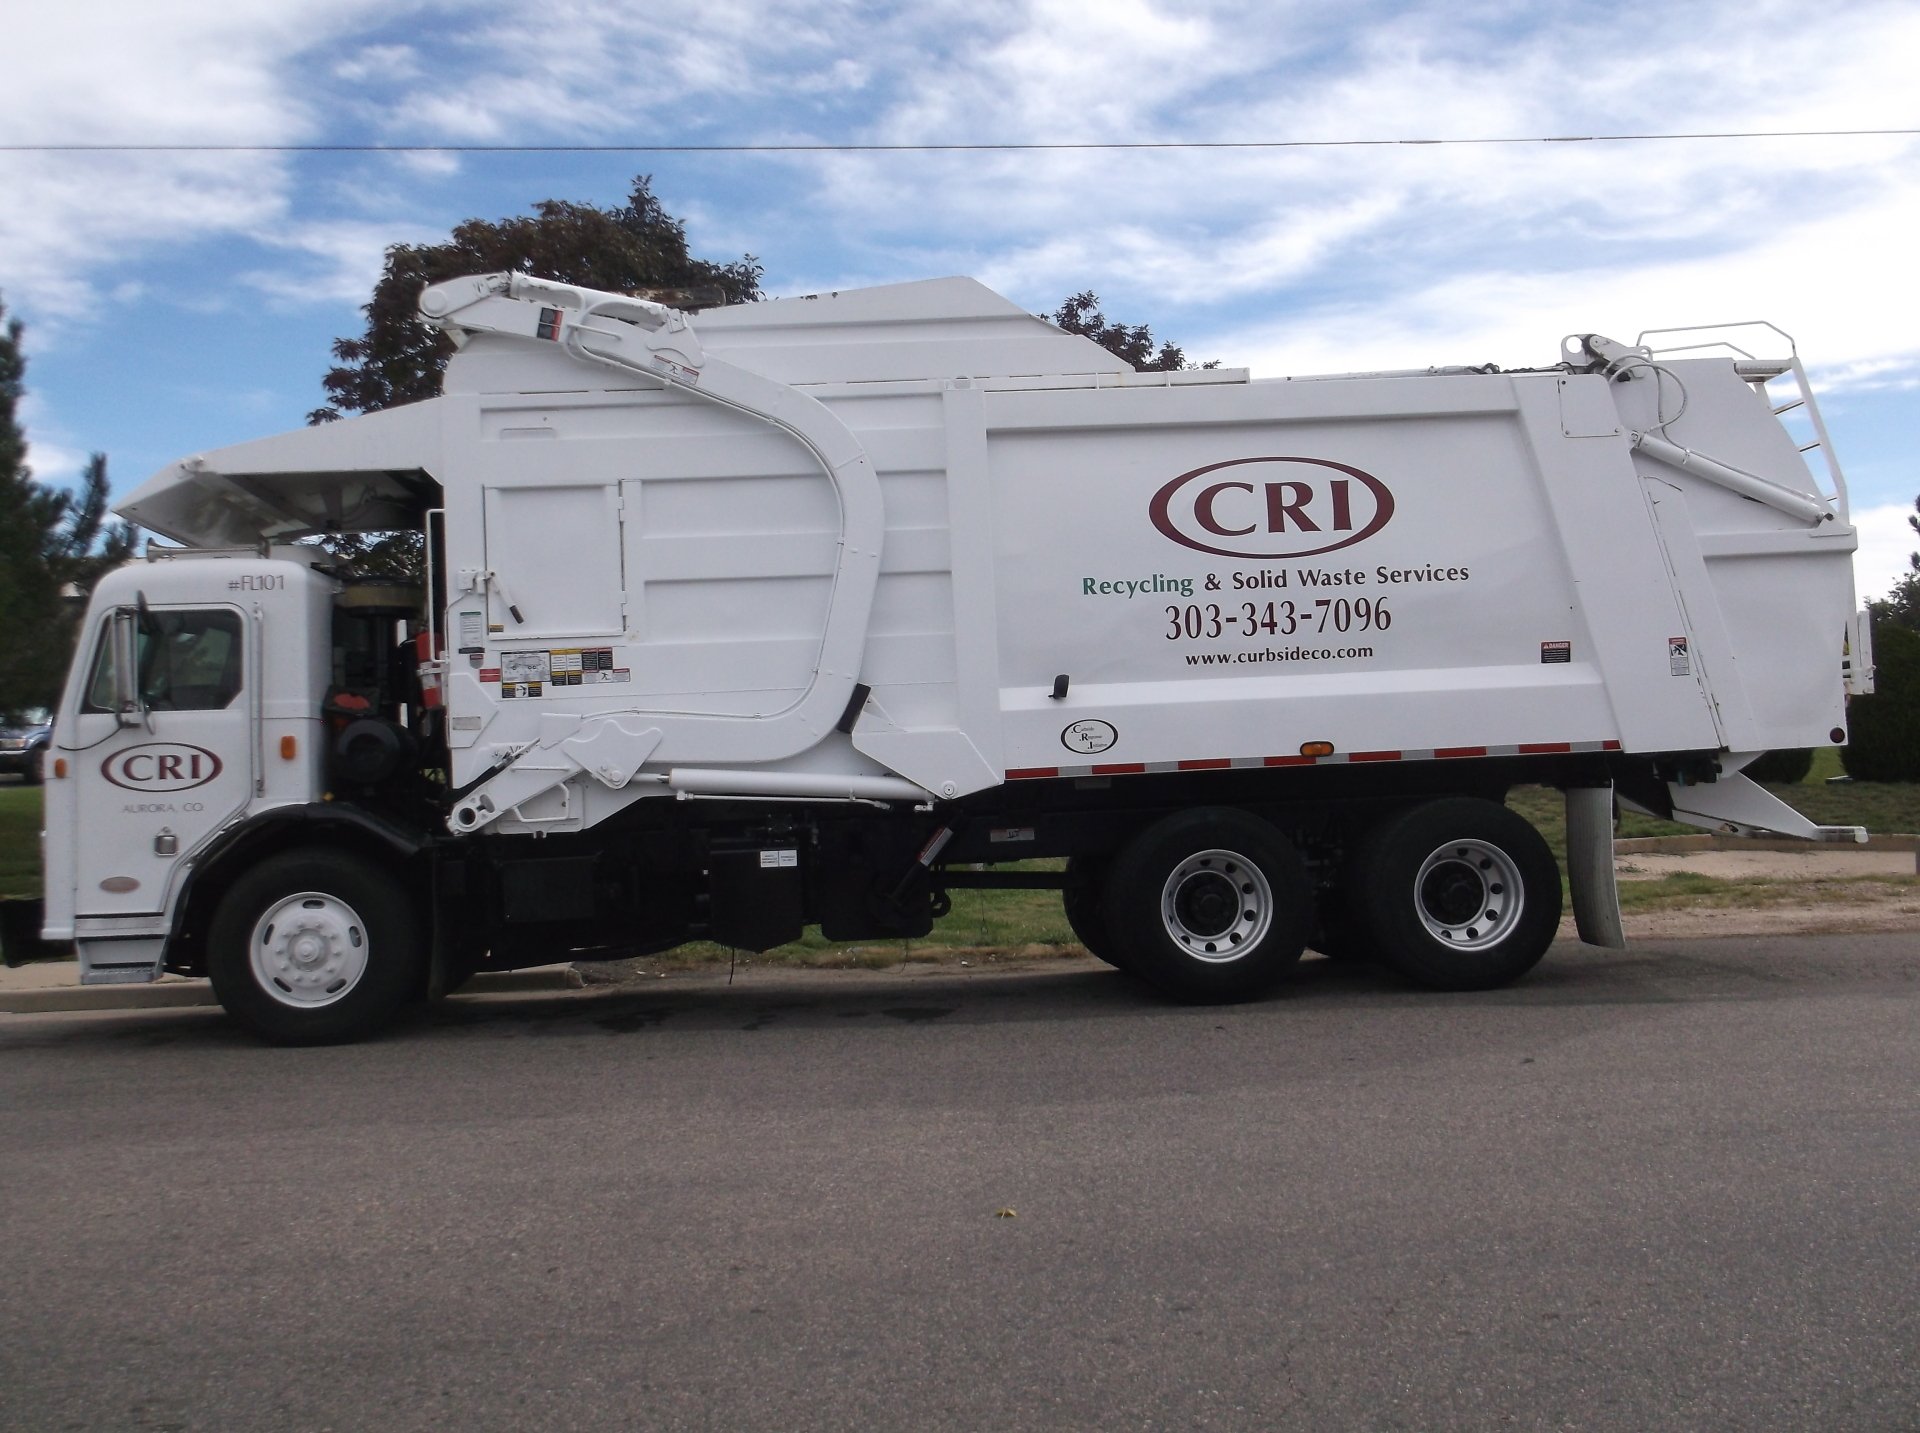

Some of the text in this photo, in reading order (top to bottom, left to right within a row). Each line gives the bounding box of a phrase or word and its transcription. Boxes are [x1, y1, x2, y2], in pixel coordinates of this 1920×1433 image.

[1194, 480, 1353, 536] CRI
[228, 575, 285, 591] #FL101
[1082, 563, 1470, 598] Recycling & Solid Waste Services
[1164, 596, 1392, 641] 303-343-7096
[1185, 644, 1374, 666] www.curbsideco.com
[123, 754, 201, 781] CRI
[183, 802, 204, 812] CO
